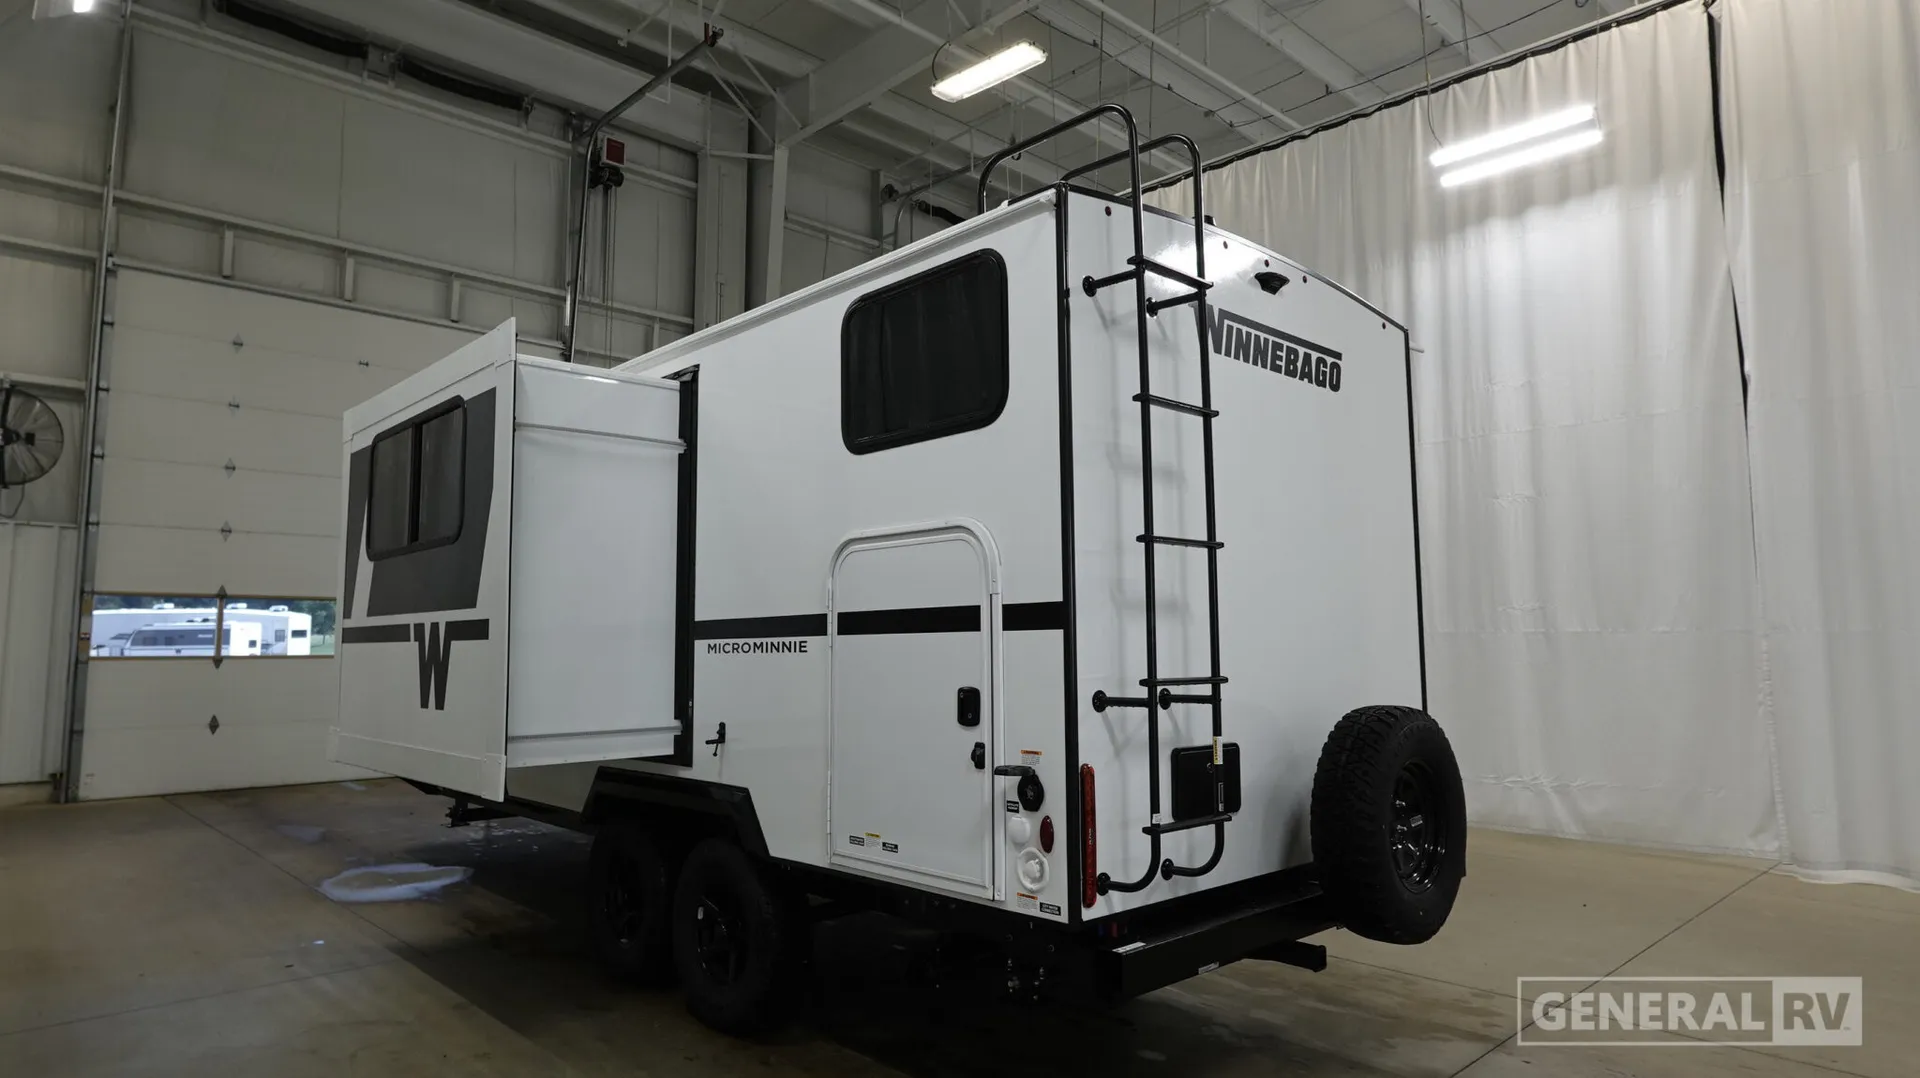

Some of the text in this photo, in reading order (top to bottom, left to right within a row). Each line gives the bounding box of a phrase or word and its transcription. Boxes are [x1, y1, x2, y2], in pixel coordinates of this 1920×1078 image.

[1188, 302, 1342, 392] WINNEBAGO
[413, 621, 451, 710] W
[707, 641, 808, 654] MICROMINNIE
